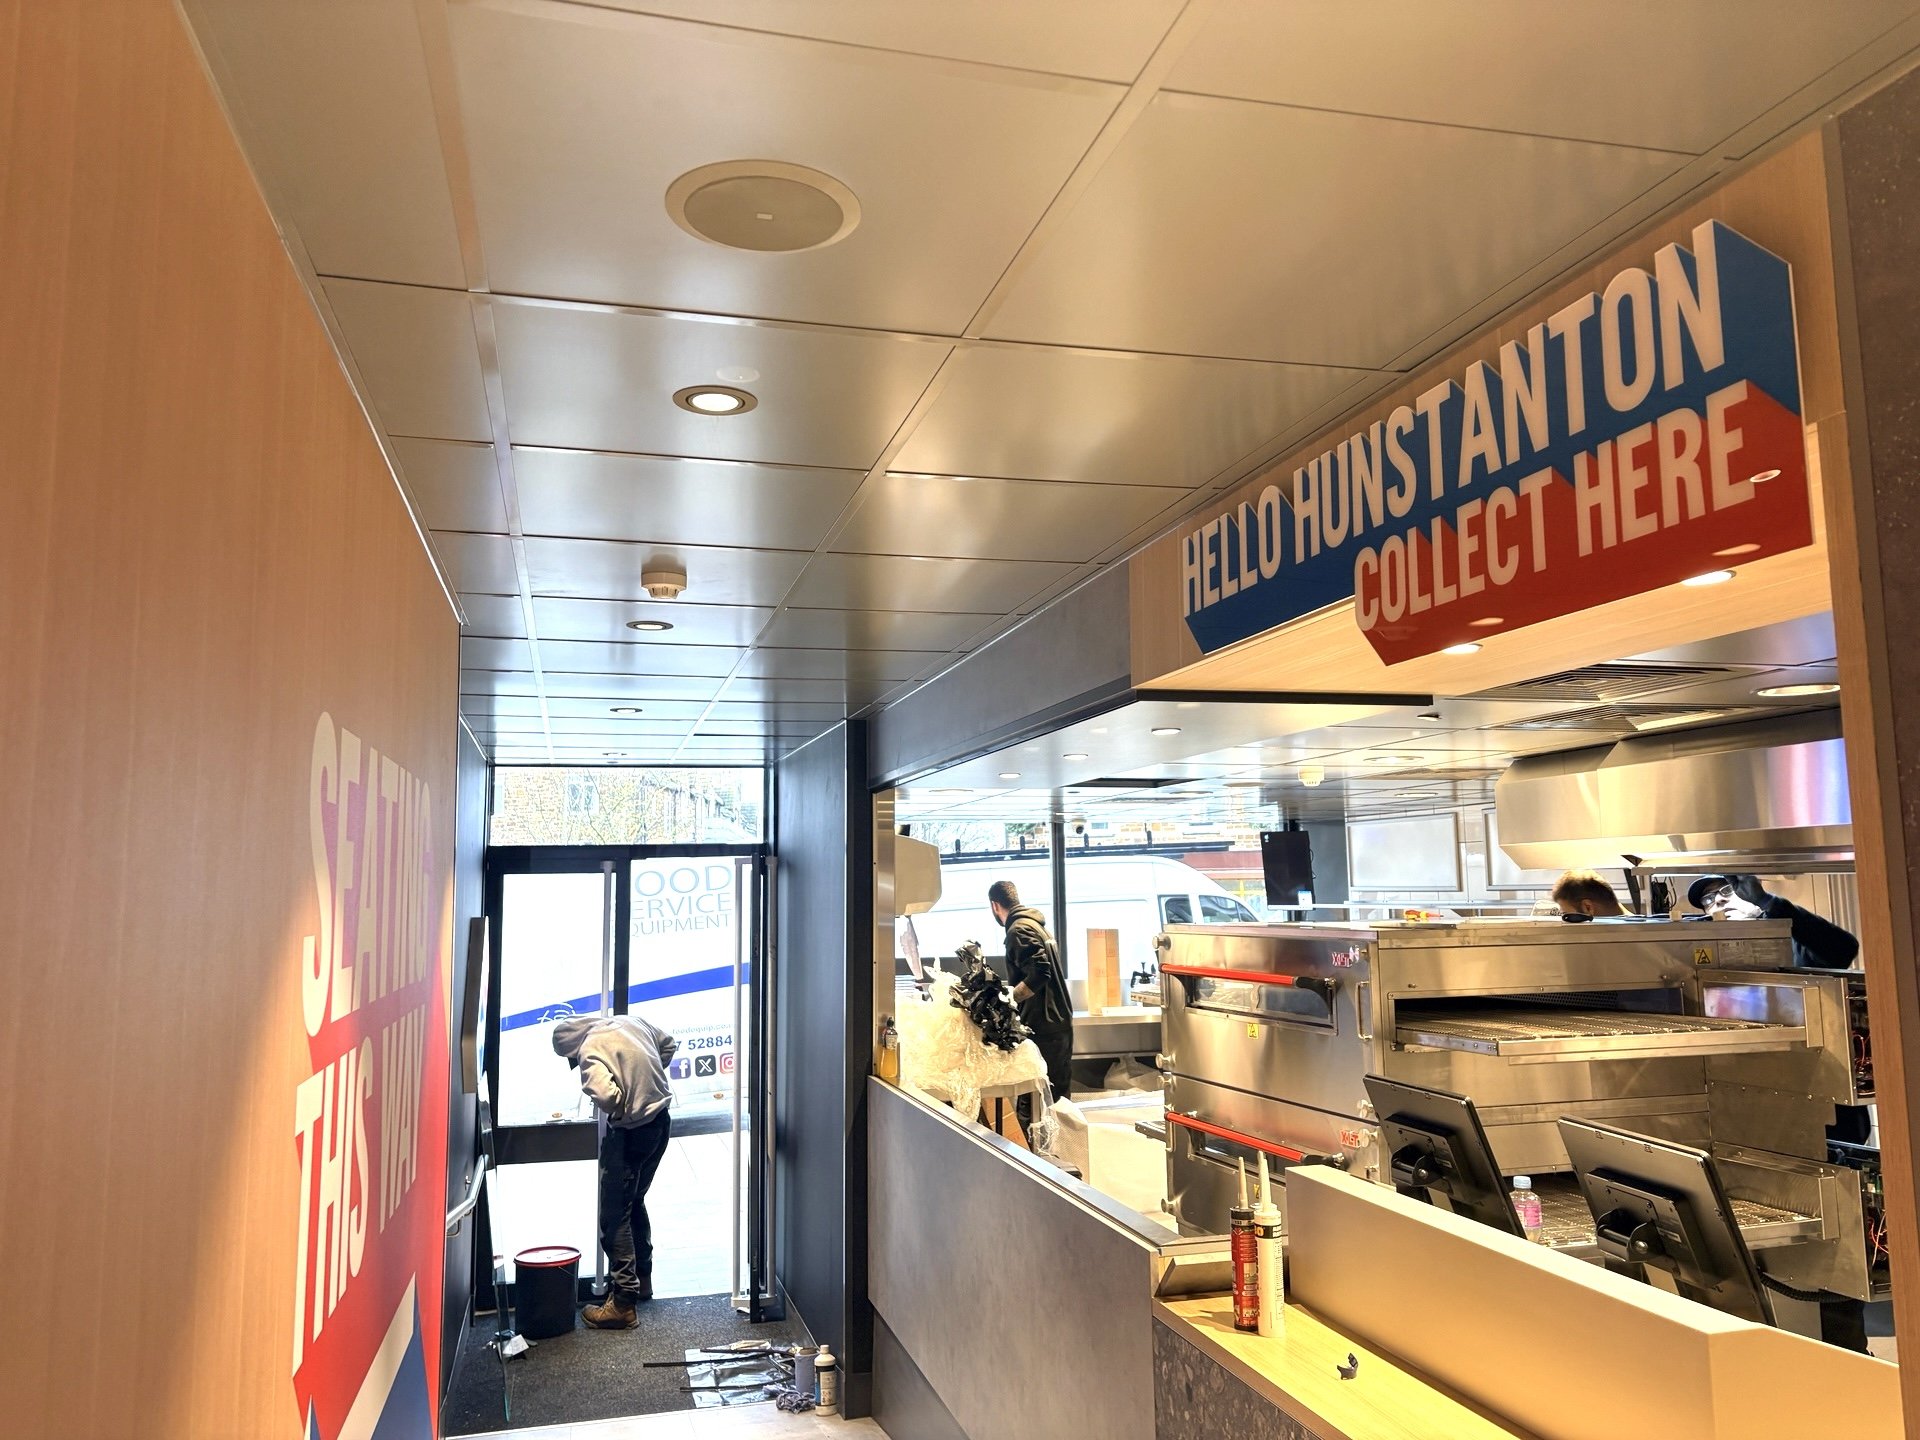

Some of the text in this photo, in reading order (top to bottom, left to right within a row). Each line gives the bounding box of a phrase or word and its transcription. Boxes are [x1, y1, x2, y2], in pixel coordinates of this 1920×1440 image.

[1182, 219, 1726, 618] HELLO HUNSTANTON
[1354, 379, 1755, 632] COLLECT HERE
[302, 711, 434, 1038] SEATING
[631, 892, 733, 920] ERVICE
[631, 914, 731, 938] QUIPMENT
[634, 865, 733, 897] OOD
[688, 1034, 733, 1051] 52884
[291, 1003, 427, 1378] THIS WAY
